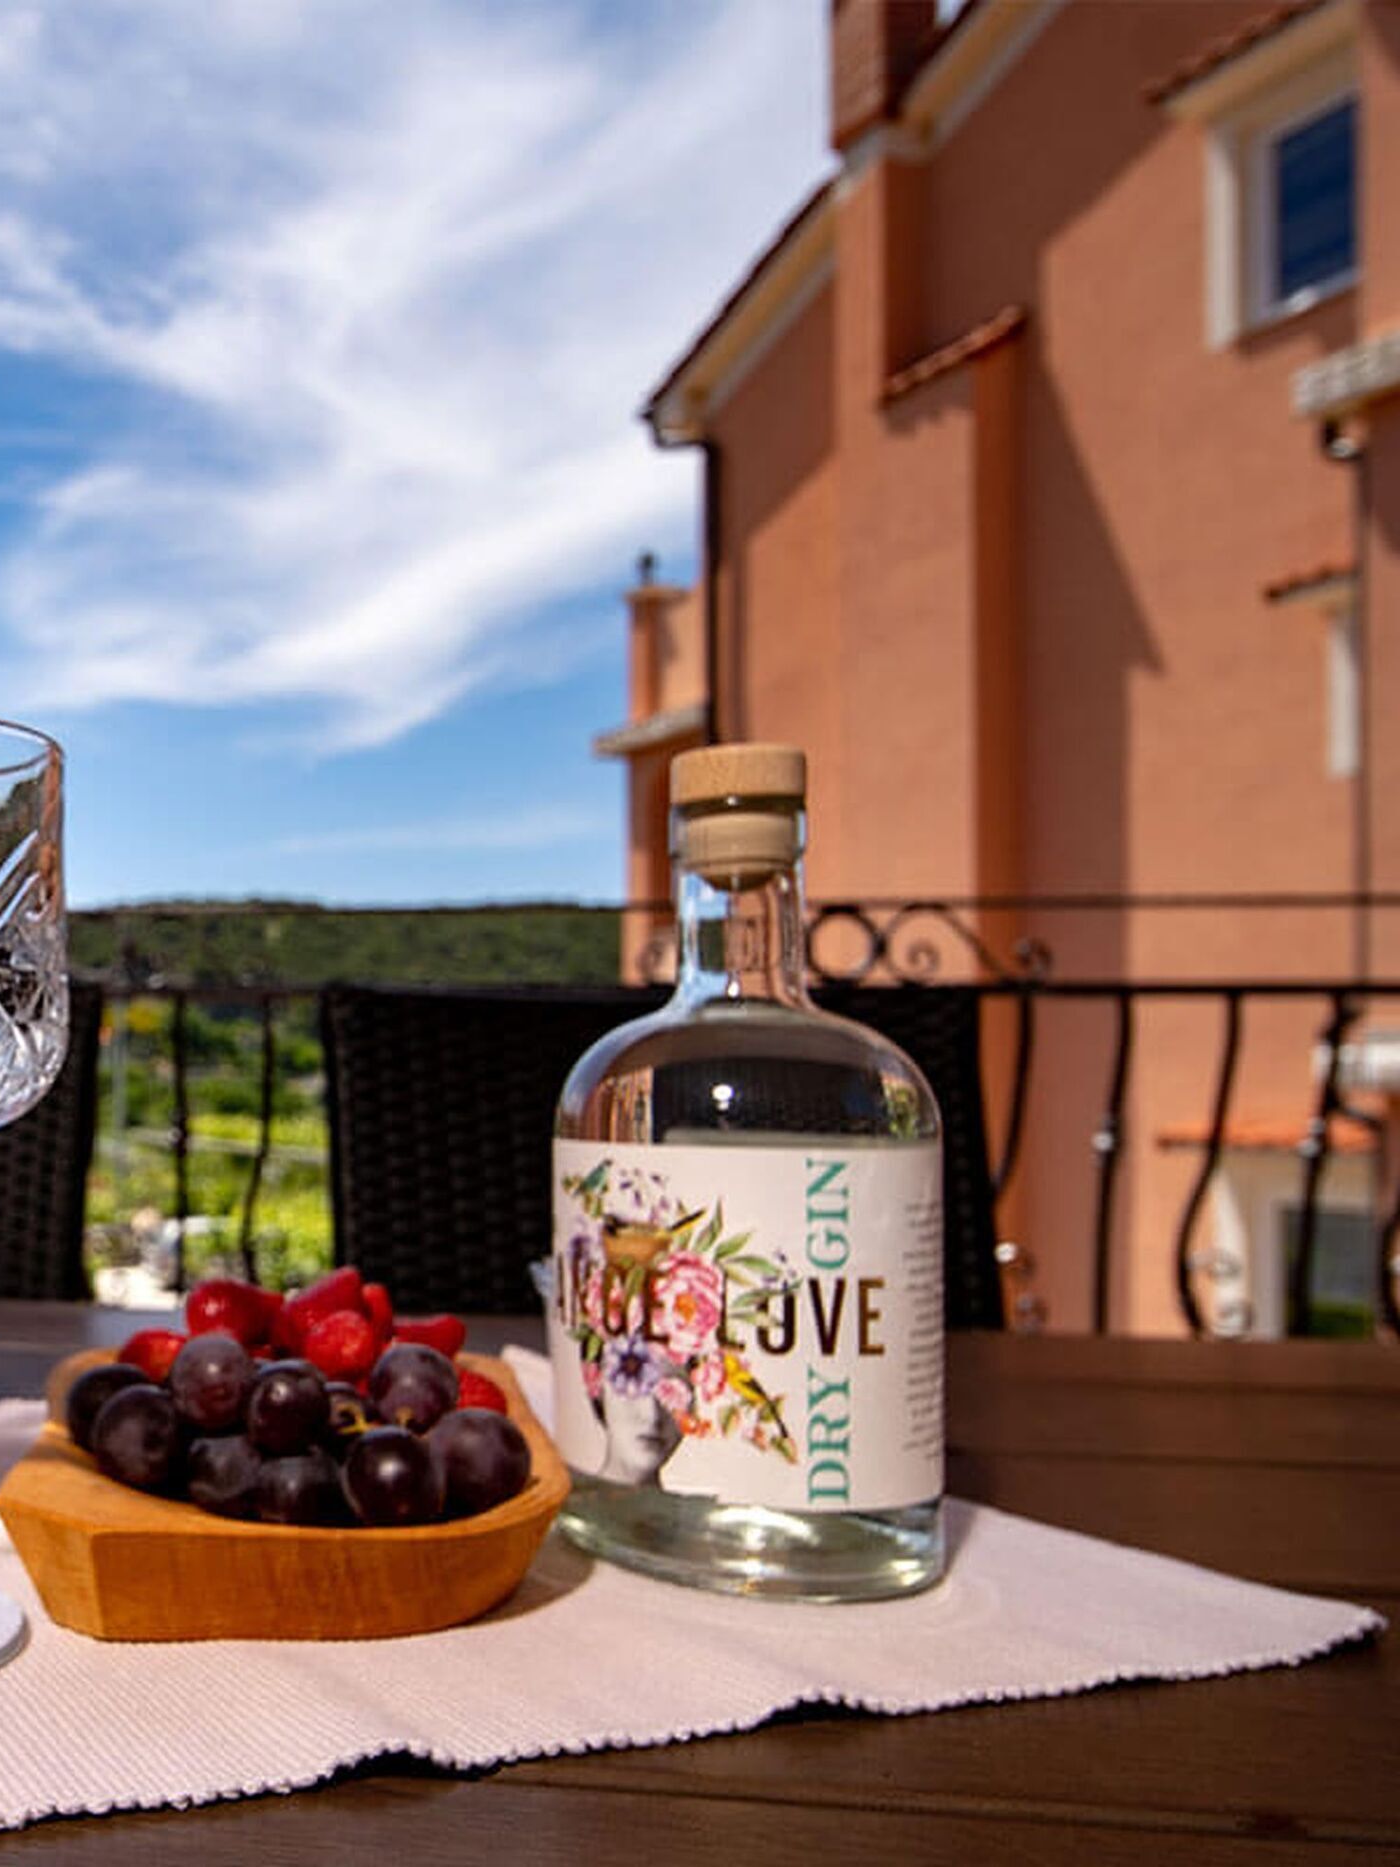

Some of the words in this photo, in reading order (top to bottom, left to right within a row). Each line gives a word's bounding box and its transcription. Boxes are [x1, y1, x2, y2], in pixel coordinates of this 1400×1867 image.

[805, 1157, 850, 1270] GIN
[716, 1271, 886, 1356] LOVE
[807, 1368, 850, 1503] DRY
